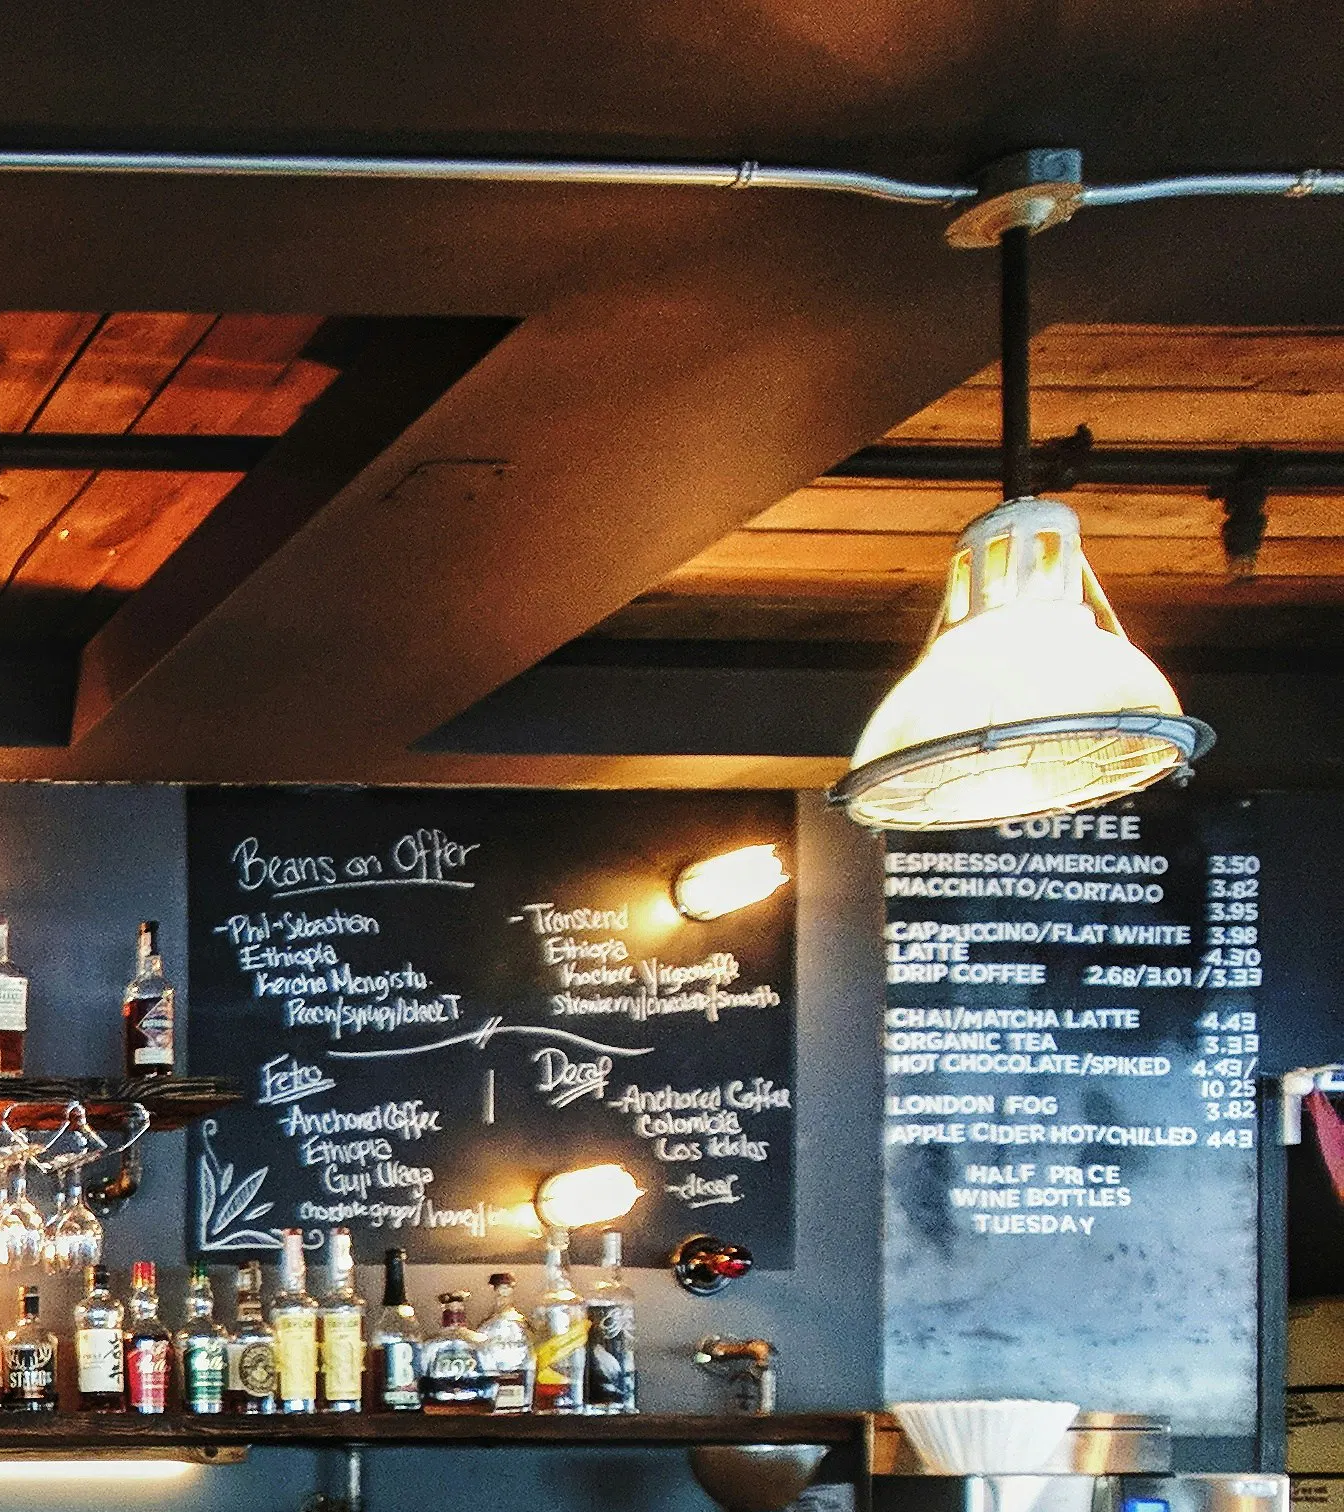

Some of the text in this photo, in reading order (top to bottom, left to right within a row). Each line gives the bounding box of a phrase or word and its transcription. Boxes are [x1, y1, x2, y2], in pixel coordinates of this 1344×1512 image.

[1002, 814, 1141, 840] COFFEE
[232, 836, 337, 890] Beans
[393, 828, 480, 881] Offer
[889, 852, 1260, 876] ESPRESSO/AMERICANO 3.50
[888, 877, 1259, 903] MACCHIATO/CORTADO 3.82
[1209, 902, 1258, 922] 3.95
[888, 921, 1257, 944] CAPPUCCINO/FLAT WHITE 3.98
[889, 942, 1261, 968] LATTE 4.30
[888, 963, 948, 984] DRIP
[950, 963, 1047, 984] COFFEE
[888, 1007, 1256, 1032] CHAI/MATCHA LATTE 4.43
[889, 1032, 1259, 1055] ORGANIC TEA 3.33
[889, 1054, 939, 1075] HOT
[941, 1053, 1171, 1076] CHOCOLATE/SPIKED
[889, 1095, 1256, 1121] LONDON FOG 3.82
[888, 1123, 965, 1145] APPLE
[970, 1122, 1045, 1144] CIDER
[1051, 1124, 1197, 1146] HOT/CHILLED
[965, 1165, 1121, 1185] HALF PRICE
[952, 1187, 1132, 1209] WINE BOTTLES
[974, 1214, 1095, 1235] TUESDAY
